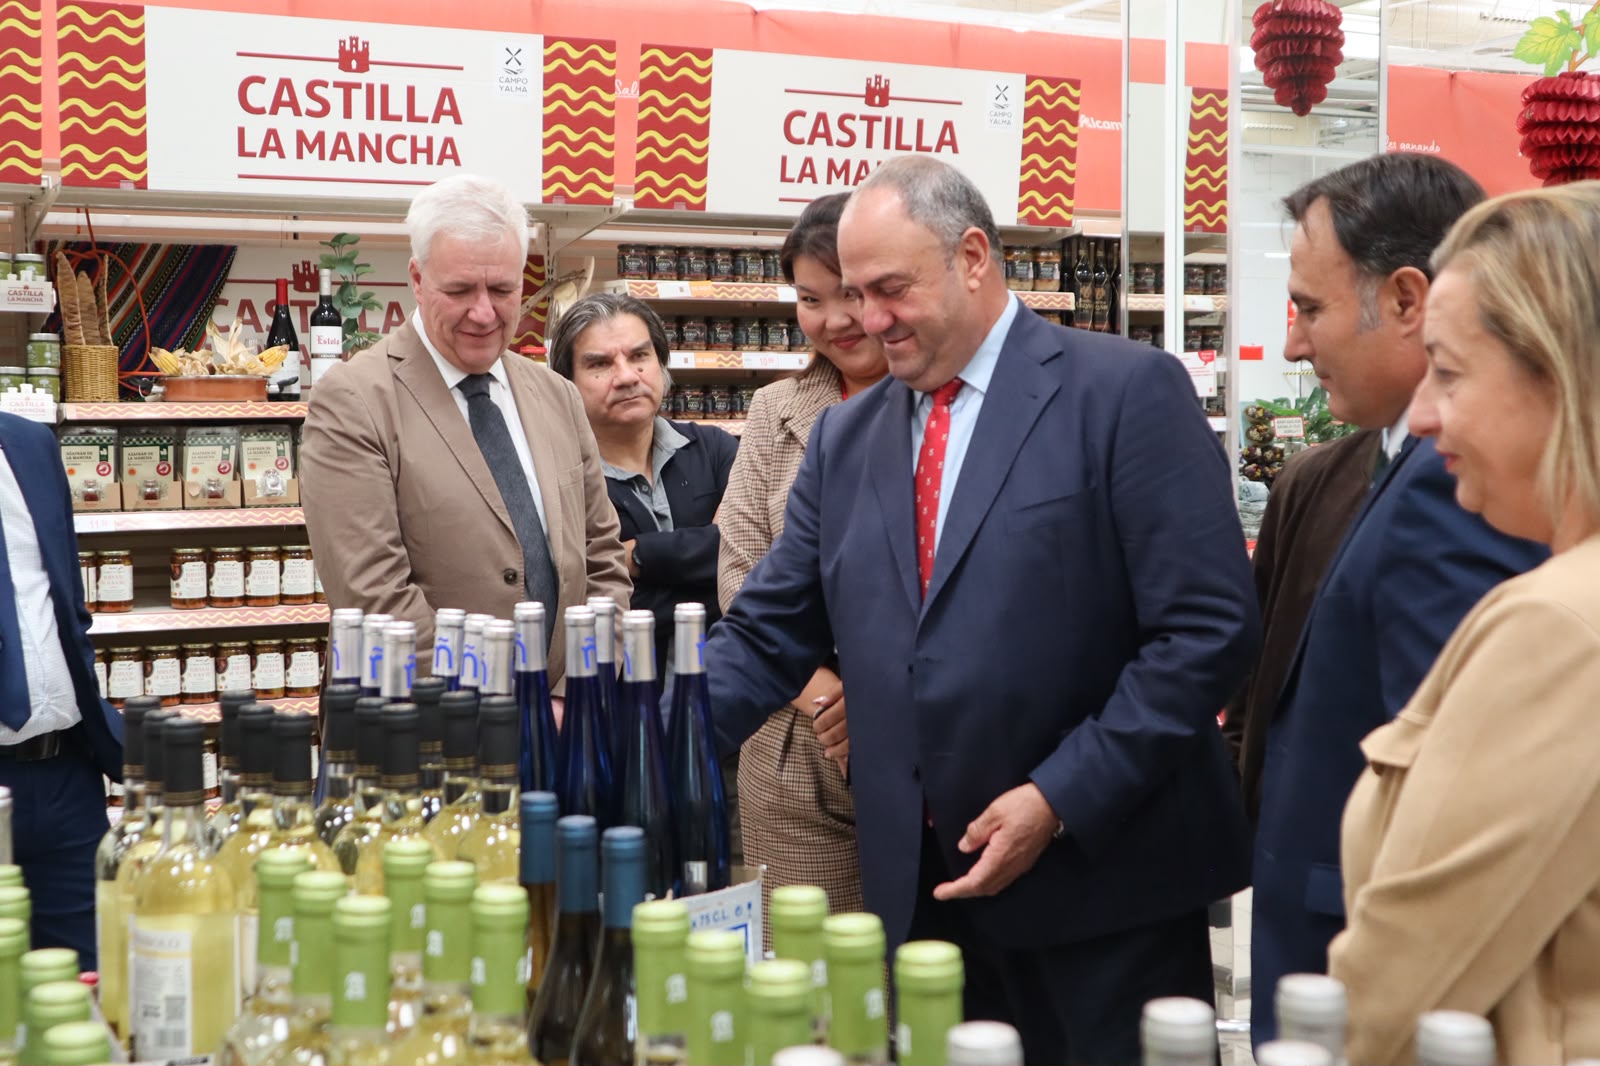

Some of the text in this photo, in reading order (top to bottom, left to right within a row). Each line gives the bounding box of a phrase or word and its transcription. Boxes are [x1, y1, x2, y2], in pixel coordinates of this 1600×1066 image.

[237, 75, 463, 125] CASTILLA
[499, 76, 528, 85] CAMPO
[237, 126, 462, 167] LA MANCHA
[783, 109, 959, 154] CASTILLA
[780, 154, 818, 186] LA
